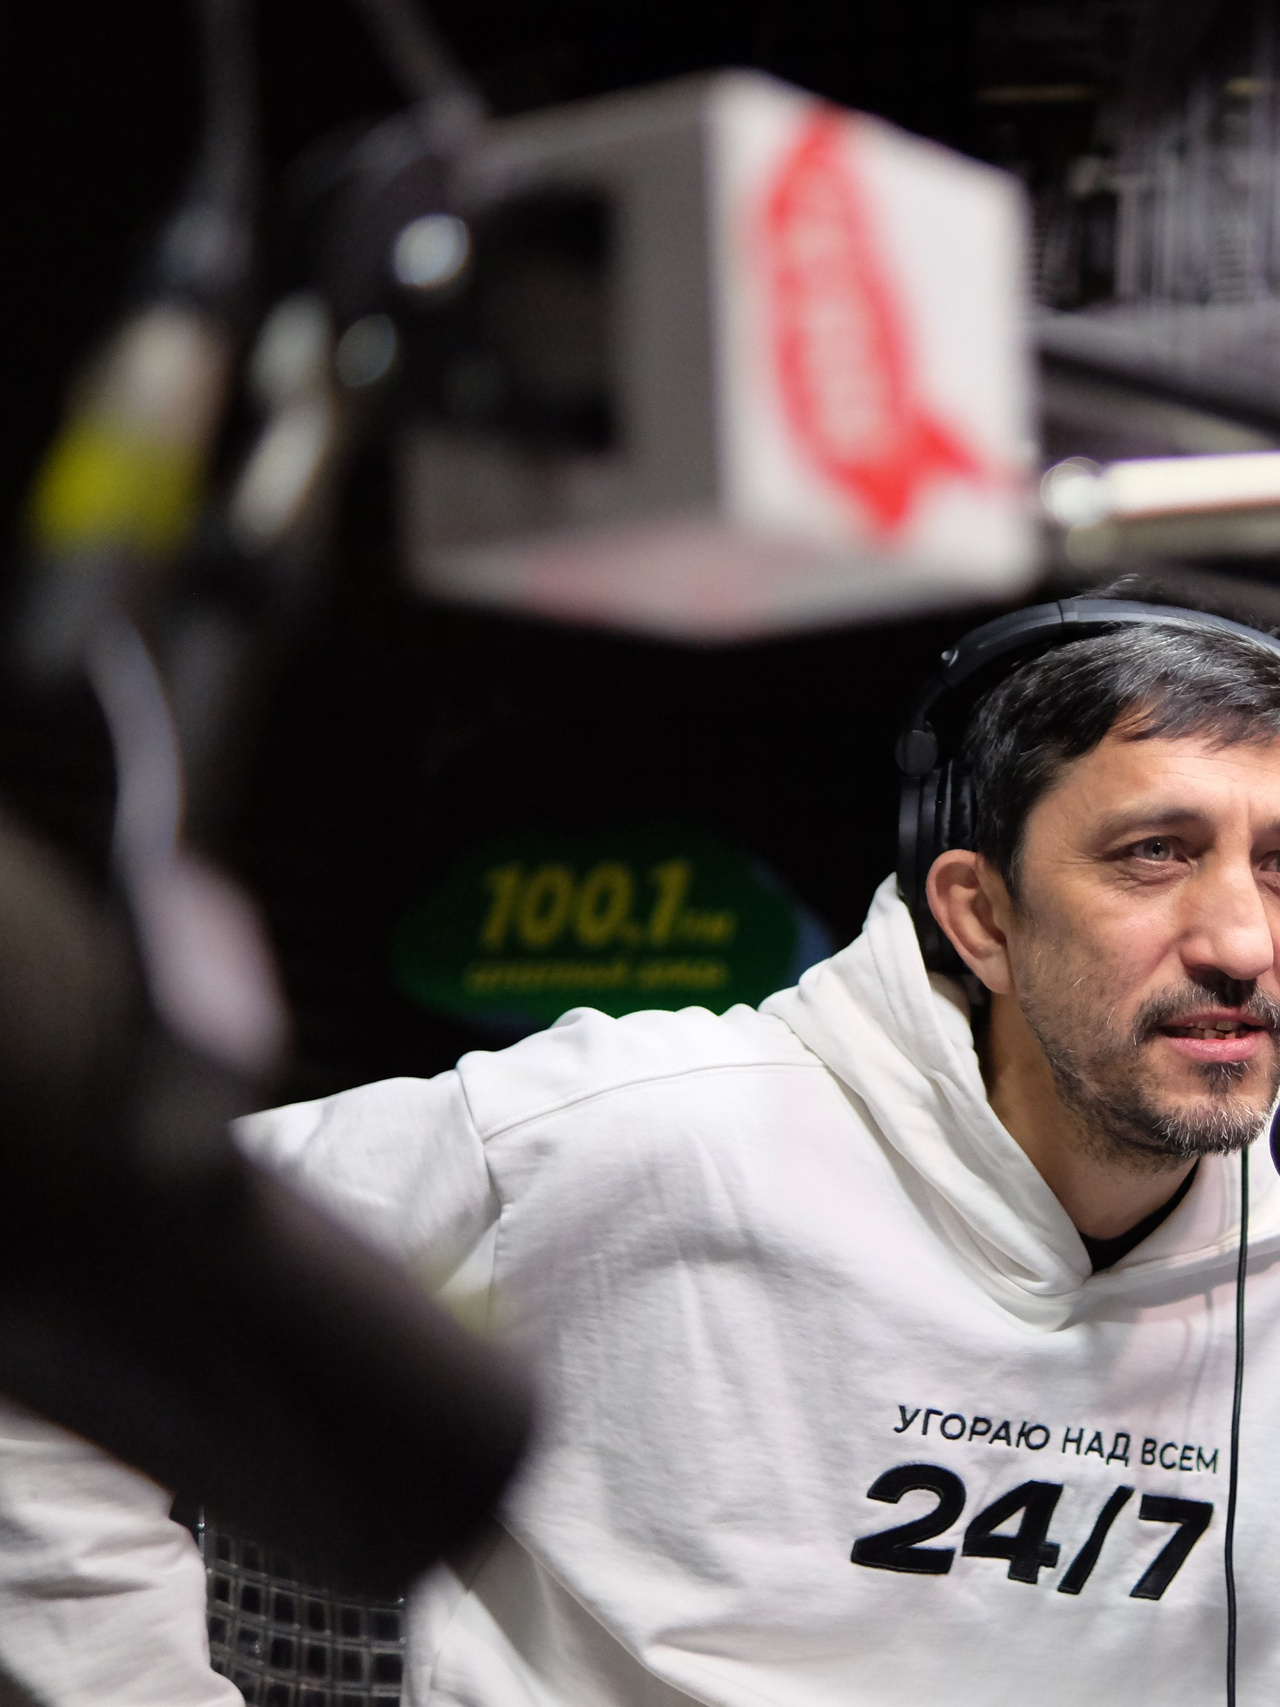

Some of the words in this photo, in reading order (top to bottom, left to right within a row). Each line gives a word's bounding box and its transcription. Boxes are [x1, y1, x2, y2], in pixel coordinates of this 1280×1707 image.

[894, 1404, 1050, 1451] УГОРАЮ
[1061, 1426, 1131, 1467] НАД
[1140, 1438, 1219, 1474] ВСЕМ
[851, 1462, 1214, 1601] 24/7
